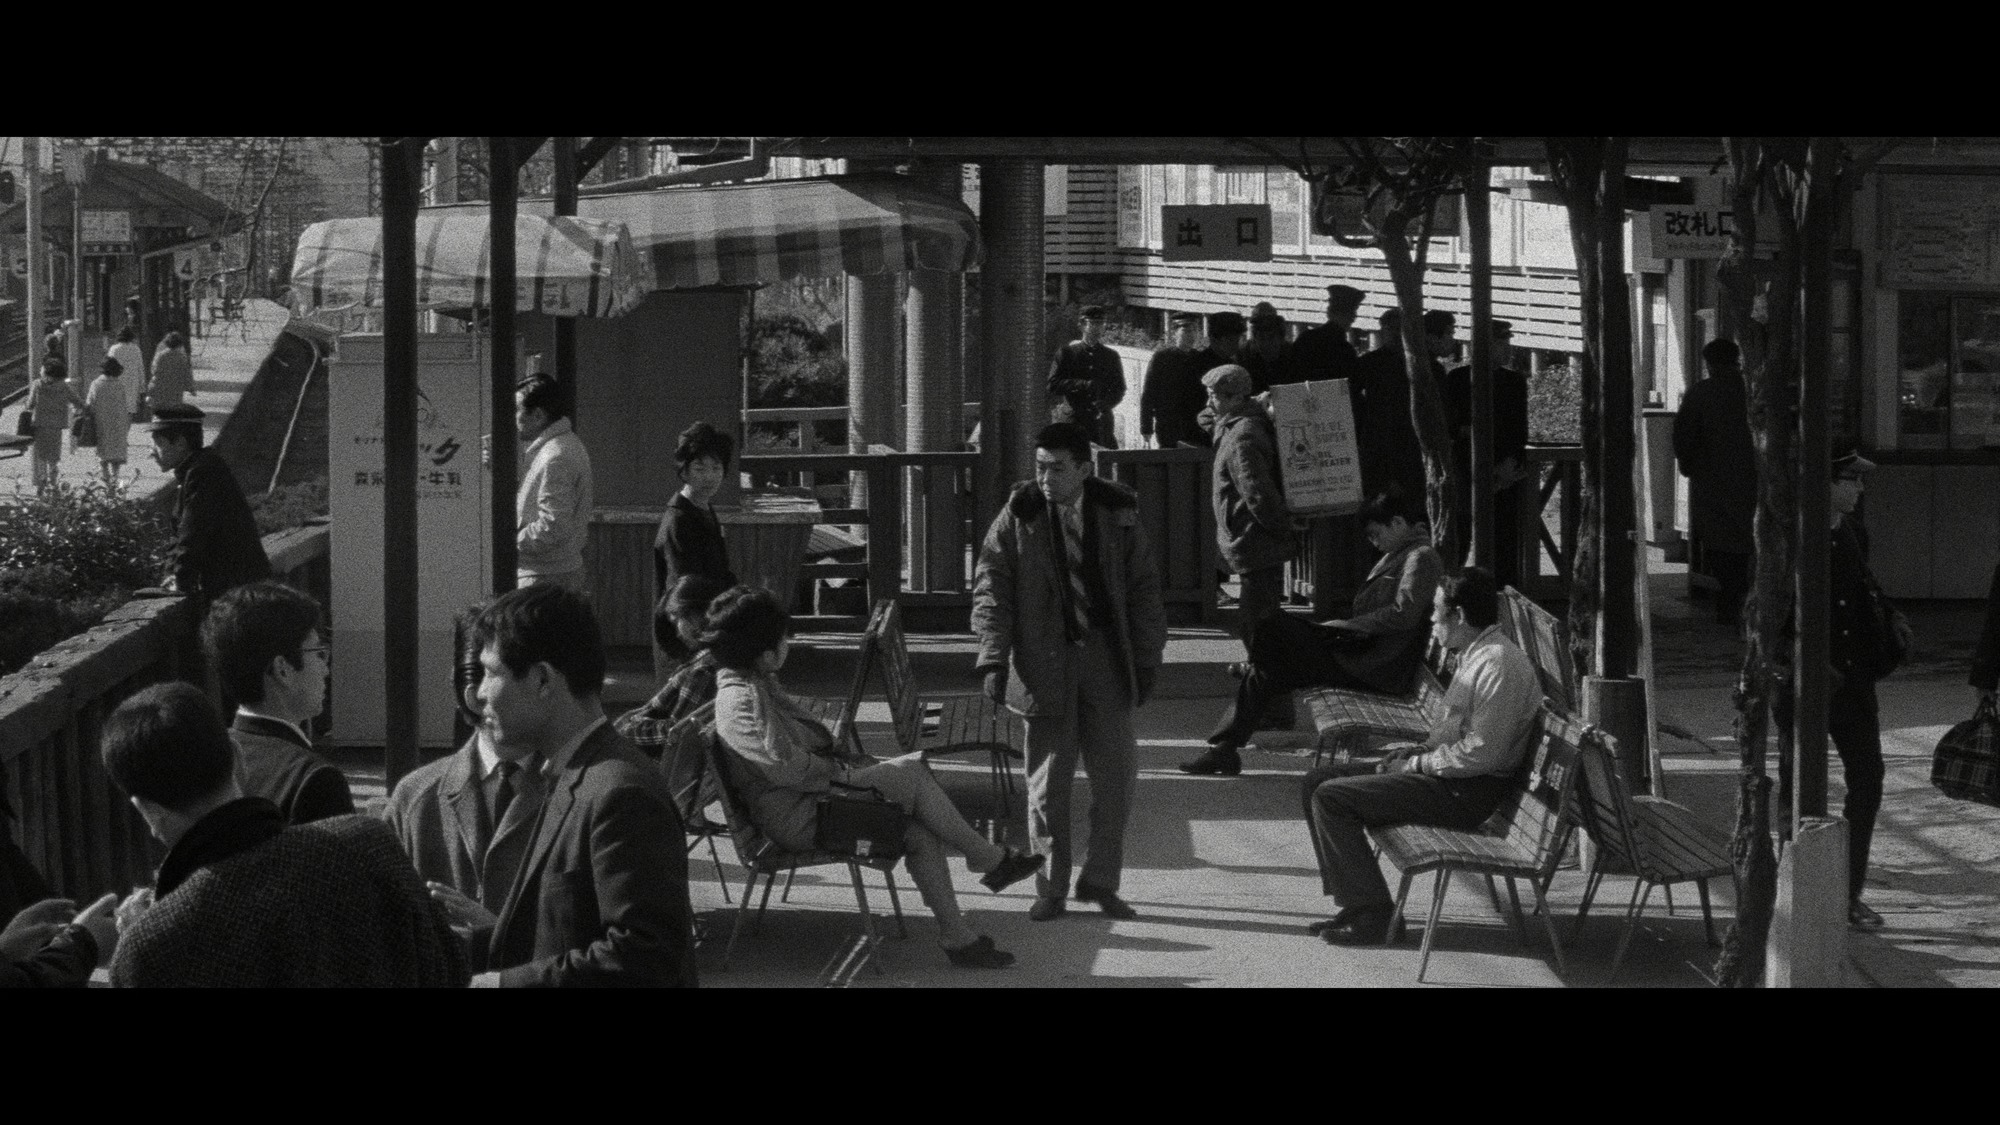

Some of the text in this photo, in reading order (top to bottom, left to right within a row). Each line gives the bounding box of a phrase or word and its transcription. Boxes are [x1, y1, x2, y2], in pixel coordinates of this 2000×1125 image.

[1177, 217, 1259, 247] 出口
[1664, 211, 1735, 237] 改札口
[16, 257, 28, 275] 3
[180, 258, 194, 276] 4
